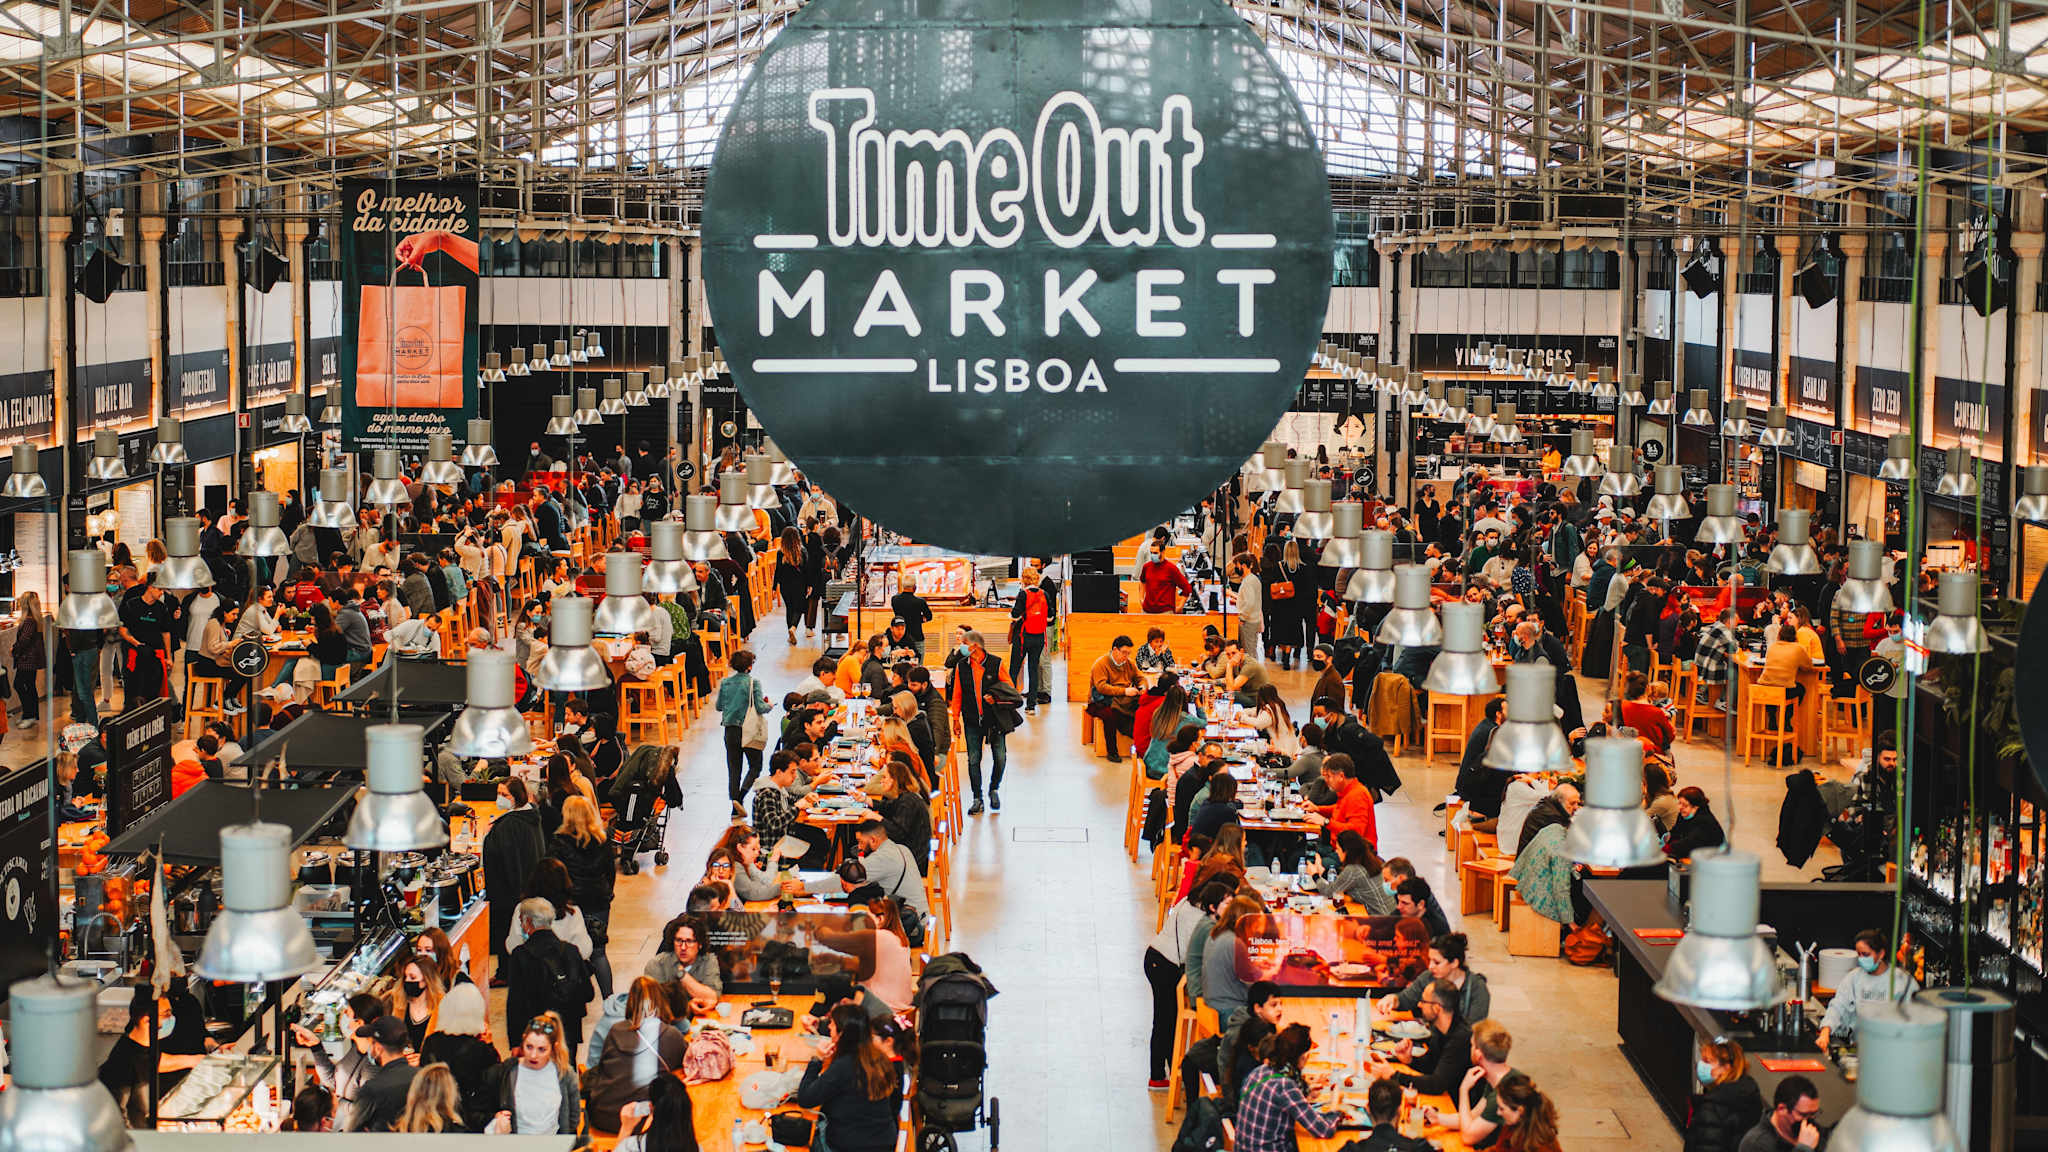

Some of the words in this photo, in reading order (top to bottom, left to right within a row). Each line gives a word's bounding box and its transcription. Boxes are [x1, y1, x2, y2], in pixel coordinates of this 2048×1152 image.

[808, 87, 1029, 248] Time
[1032, 91, 1206, 248] Out
[356, 188, 378, 214] O
[379, 192, 467, 213] melhor
[352, 212, 386, 232] da
[389, 212, 470, 234] cidade
[758, 269, 1276, 337] MARKET
[928, 357, 1108, 394] LISBOA
[1817, 378, 1827, 401] LAB
[1872, 387, 1885, 413] ZERO
[1886, 389, 1901, 416] ZERO
[366, 423, 382, 433] do
[383, 425, 423, 433] mesmo
[373, 413, 408, 425] agora
[408, 412, 446, 423] dentro
